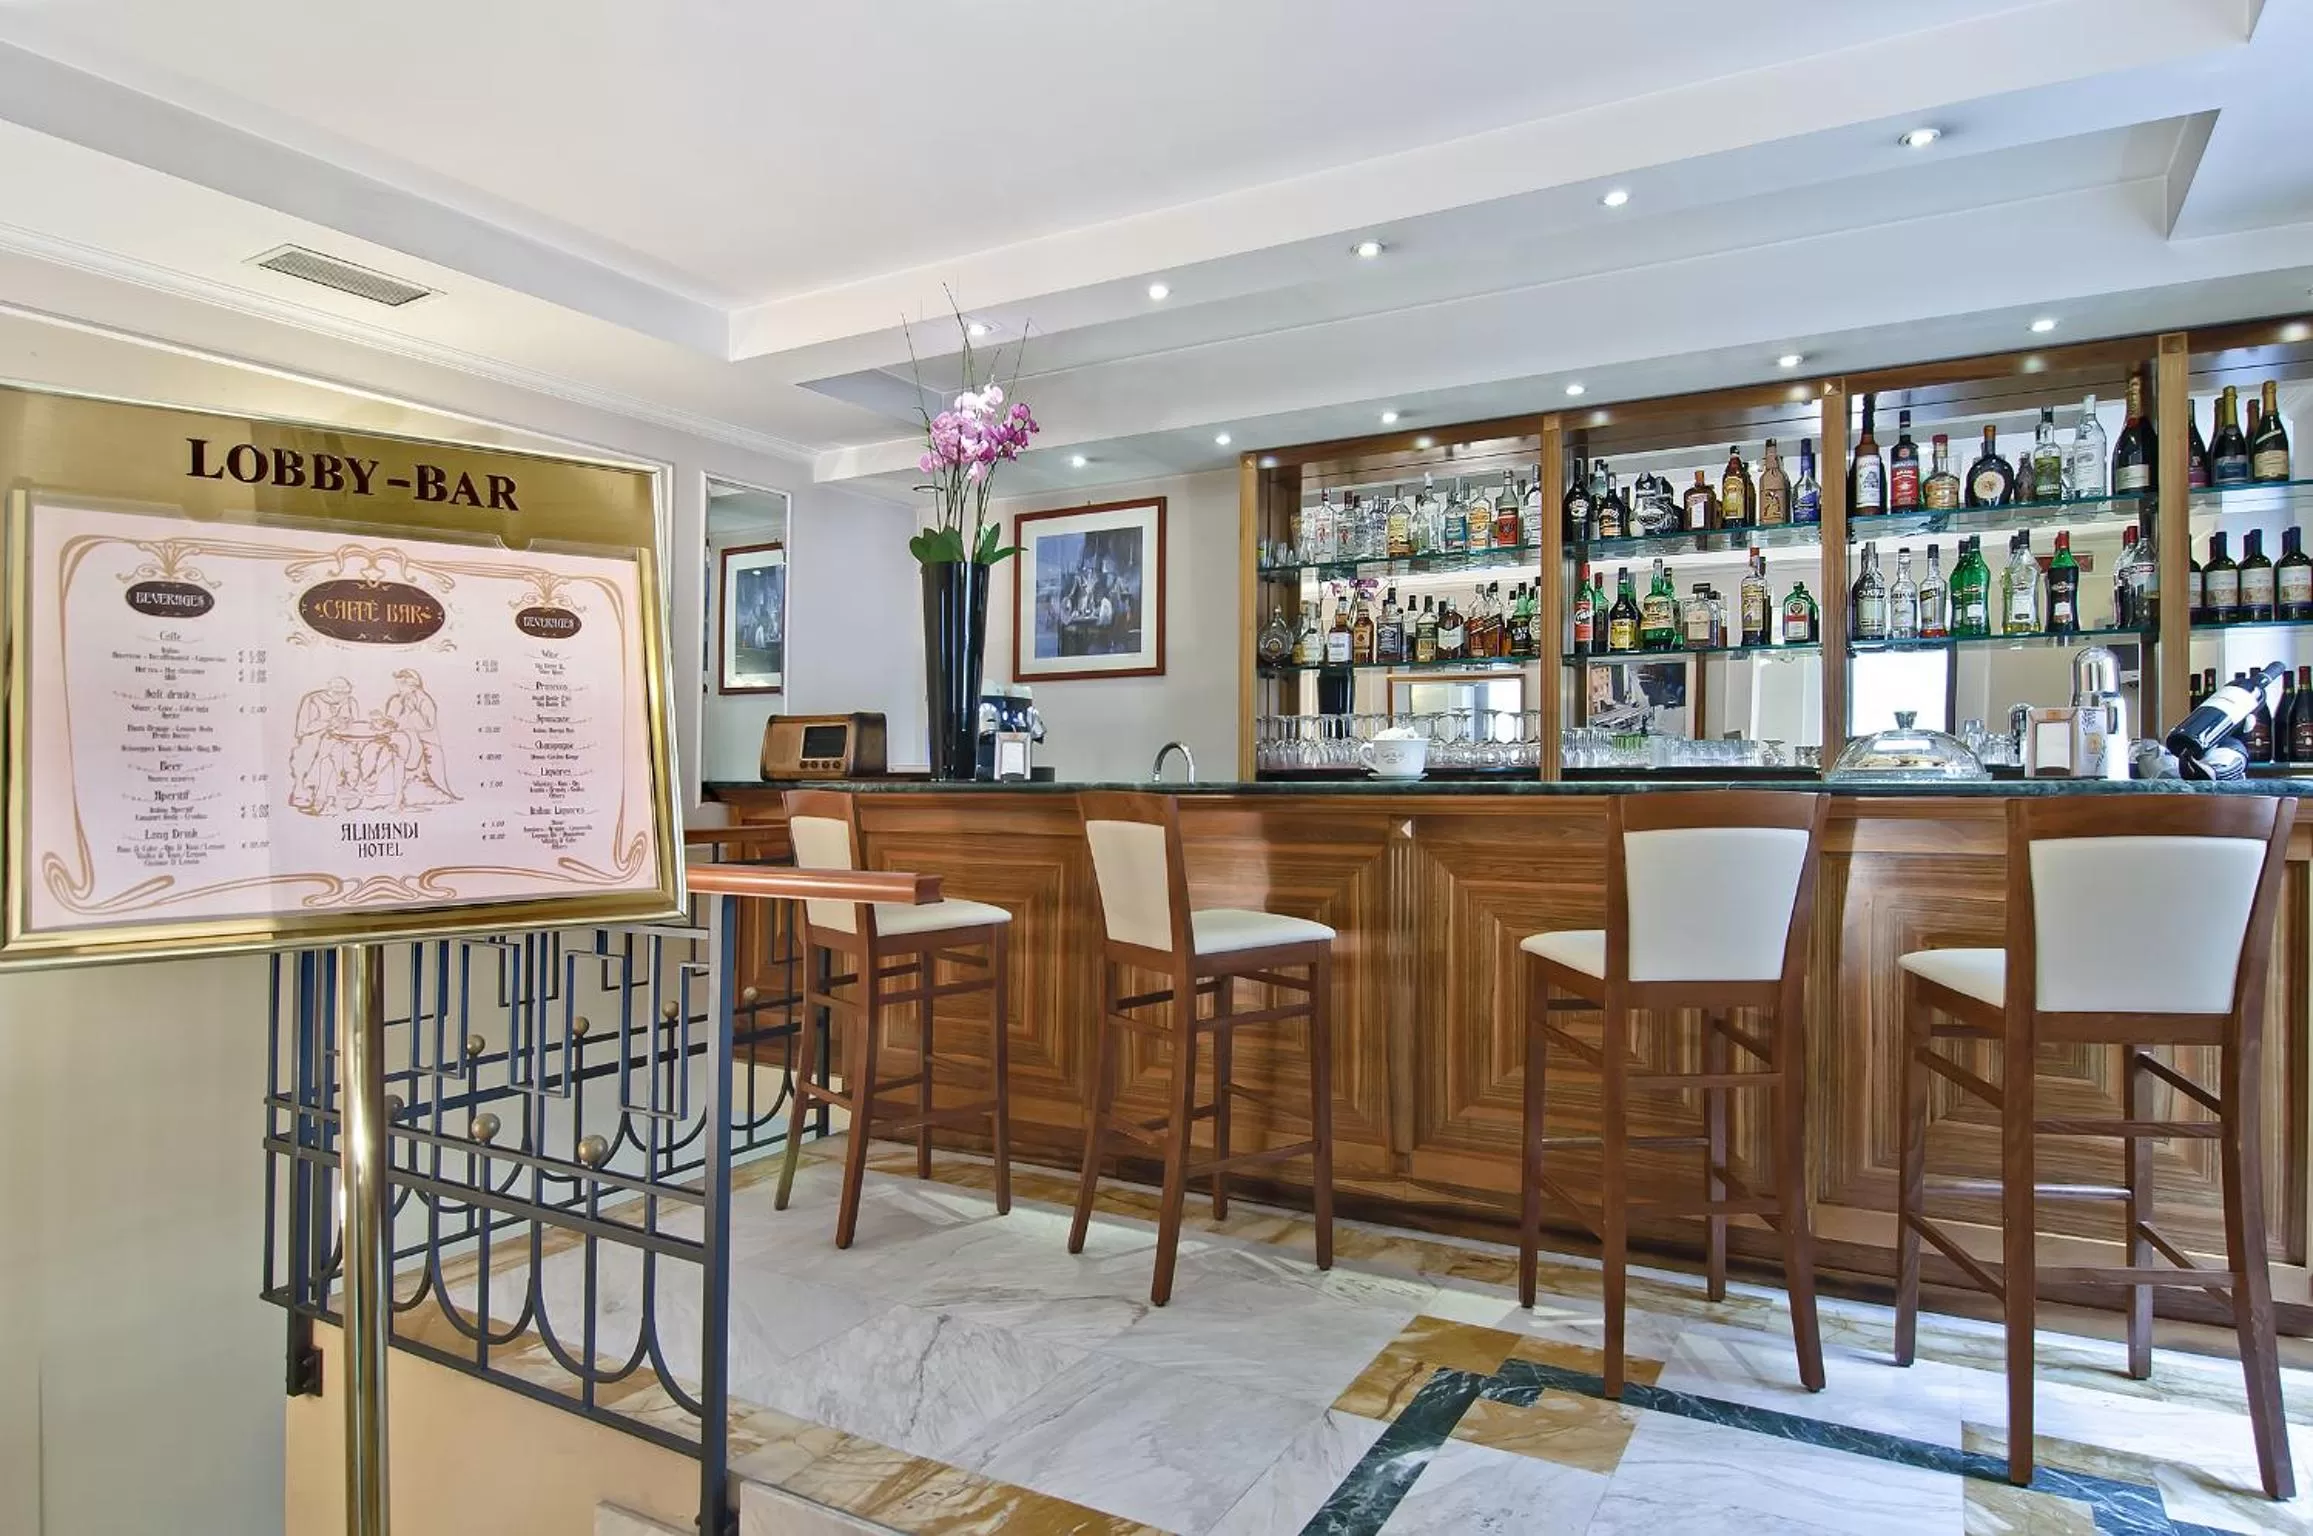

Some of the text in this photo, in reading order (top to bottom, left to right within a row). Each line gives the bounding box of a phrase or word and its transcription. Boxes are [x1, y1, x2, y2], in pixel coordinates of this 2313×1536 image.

[135, 590, 204, 608] BEVERAGES
[386, 603, 424, 624] BAR
[523, 616, 574, 630] BEVERAGES
[159, 760, 183, 771] Beer
[154, 790, 190, 802] Aperitif
[341, 822, 419, 841] ALIMANDI
[358, 842, 404, 858] HOTEL
